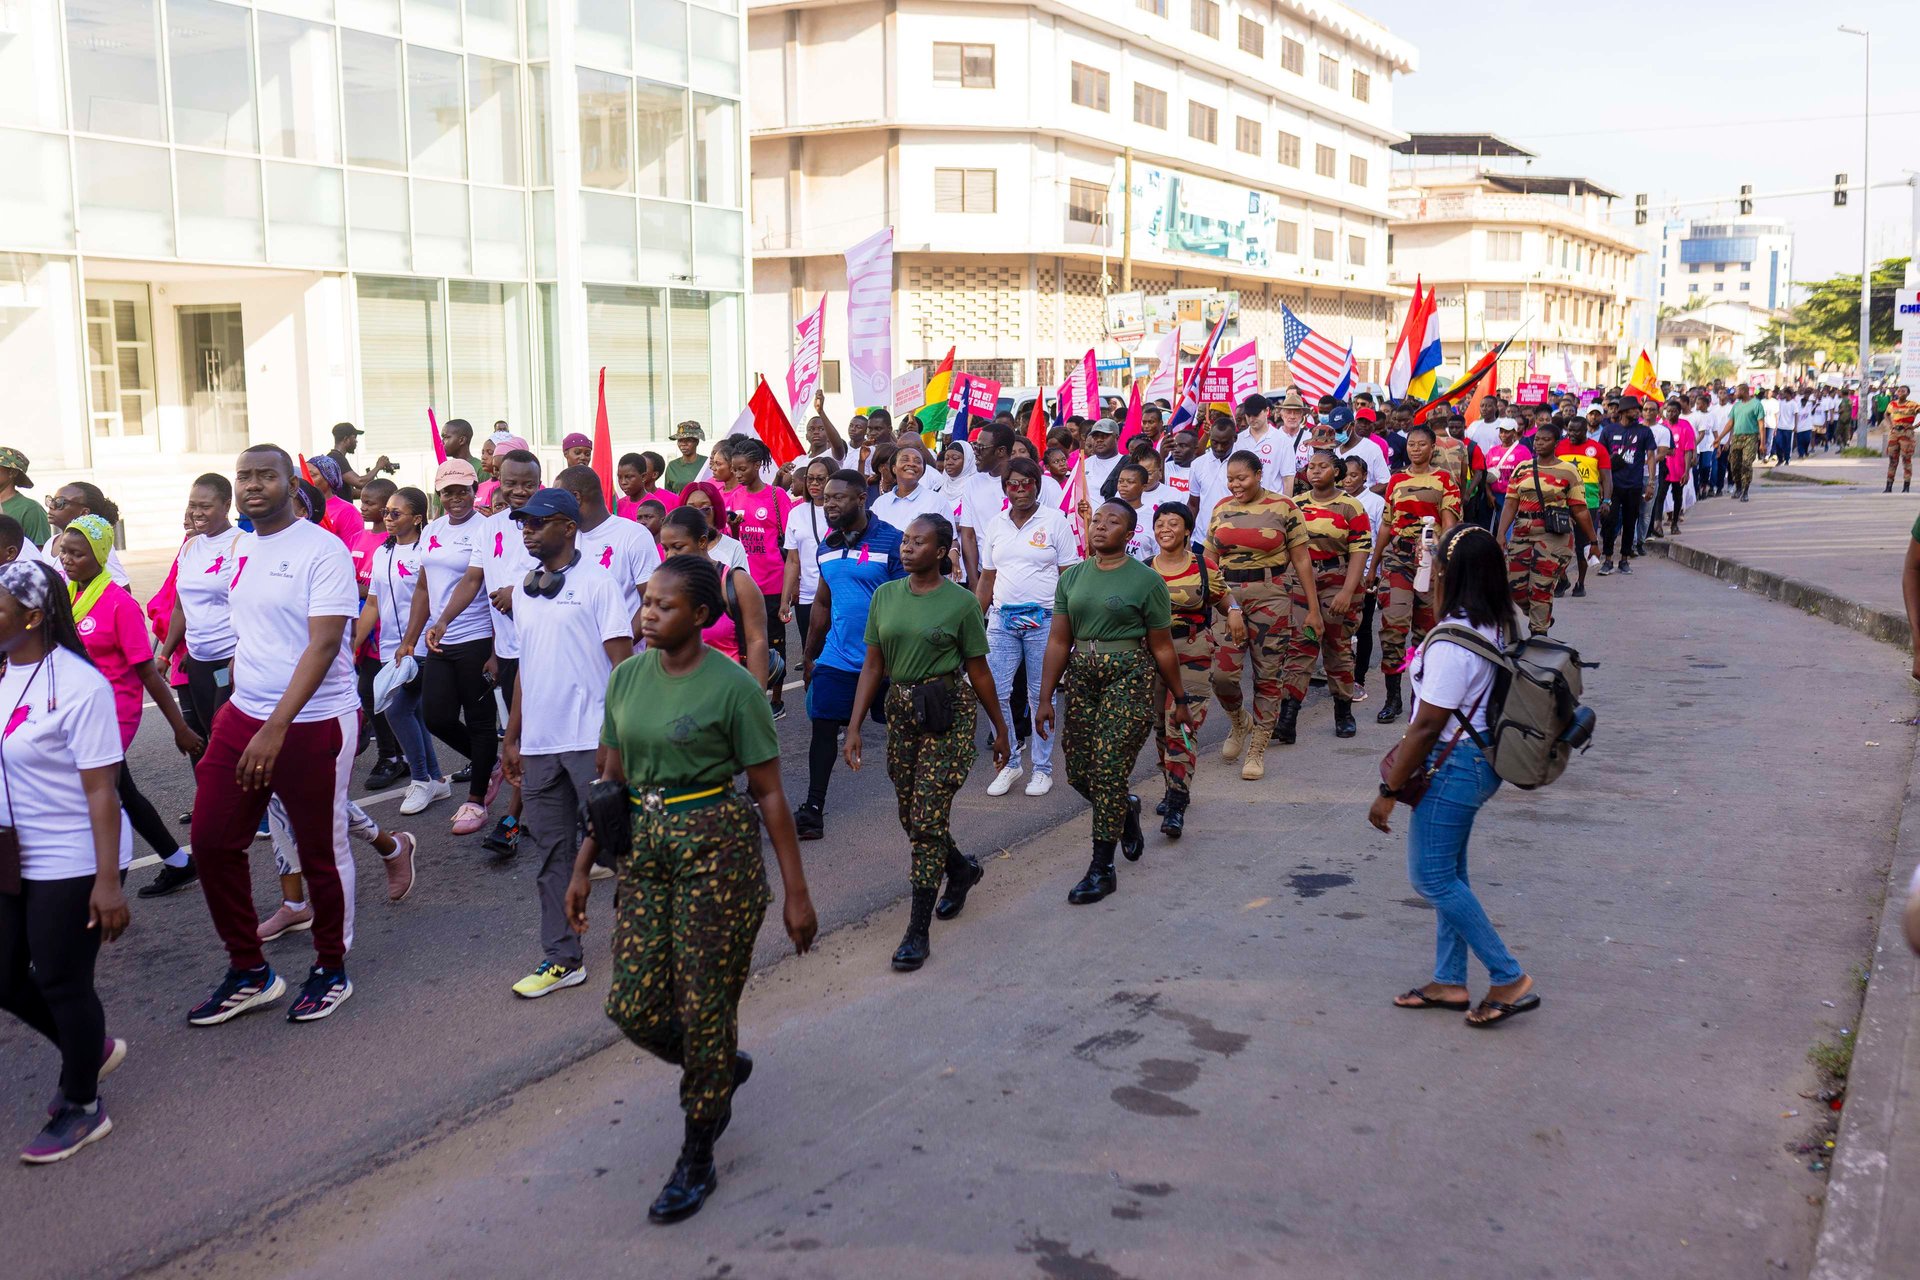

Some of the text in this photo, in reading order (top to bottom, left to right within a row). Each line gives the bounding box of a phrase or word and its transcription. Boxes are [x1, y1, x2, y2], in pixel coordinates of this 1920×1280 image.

[1108, 358, 1128, 367] STREET
[1218, 377, 1228, 385] THE
[1204, 385, 1229, 393] FIGHTING
[971, 389, 982, 399] TOO
[1201, 392, 1226, 401] THE CURE
[972, 399, 994, 412] CANCER
